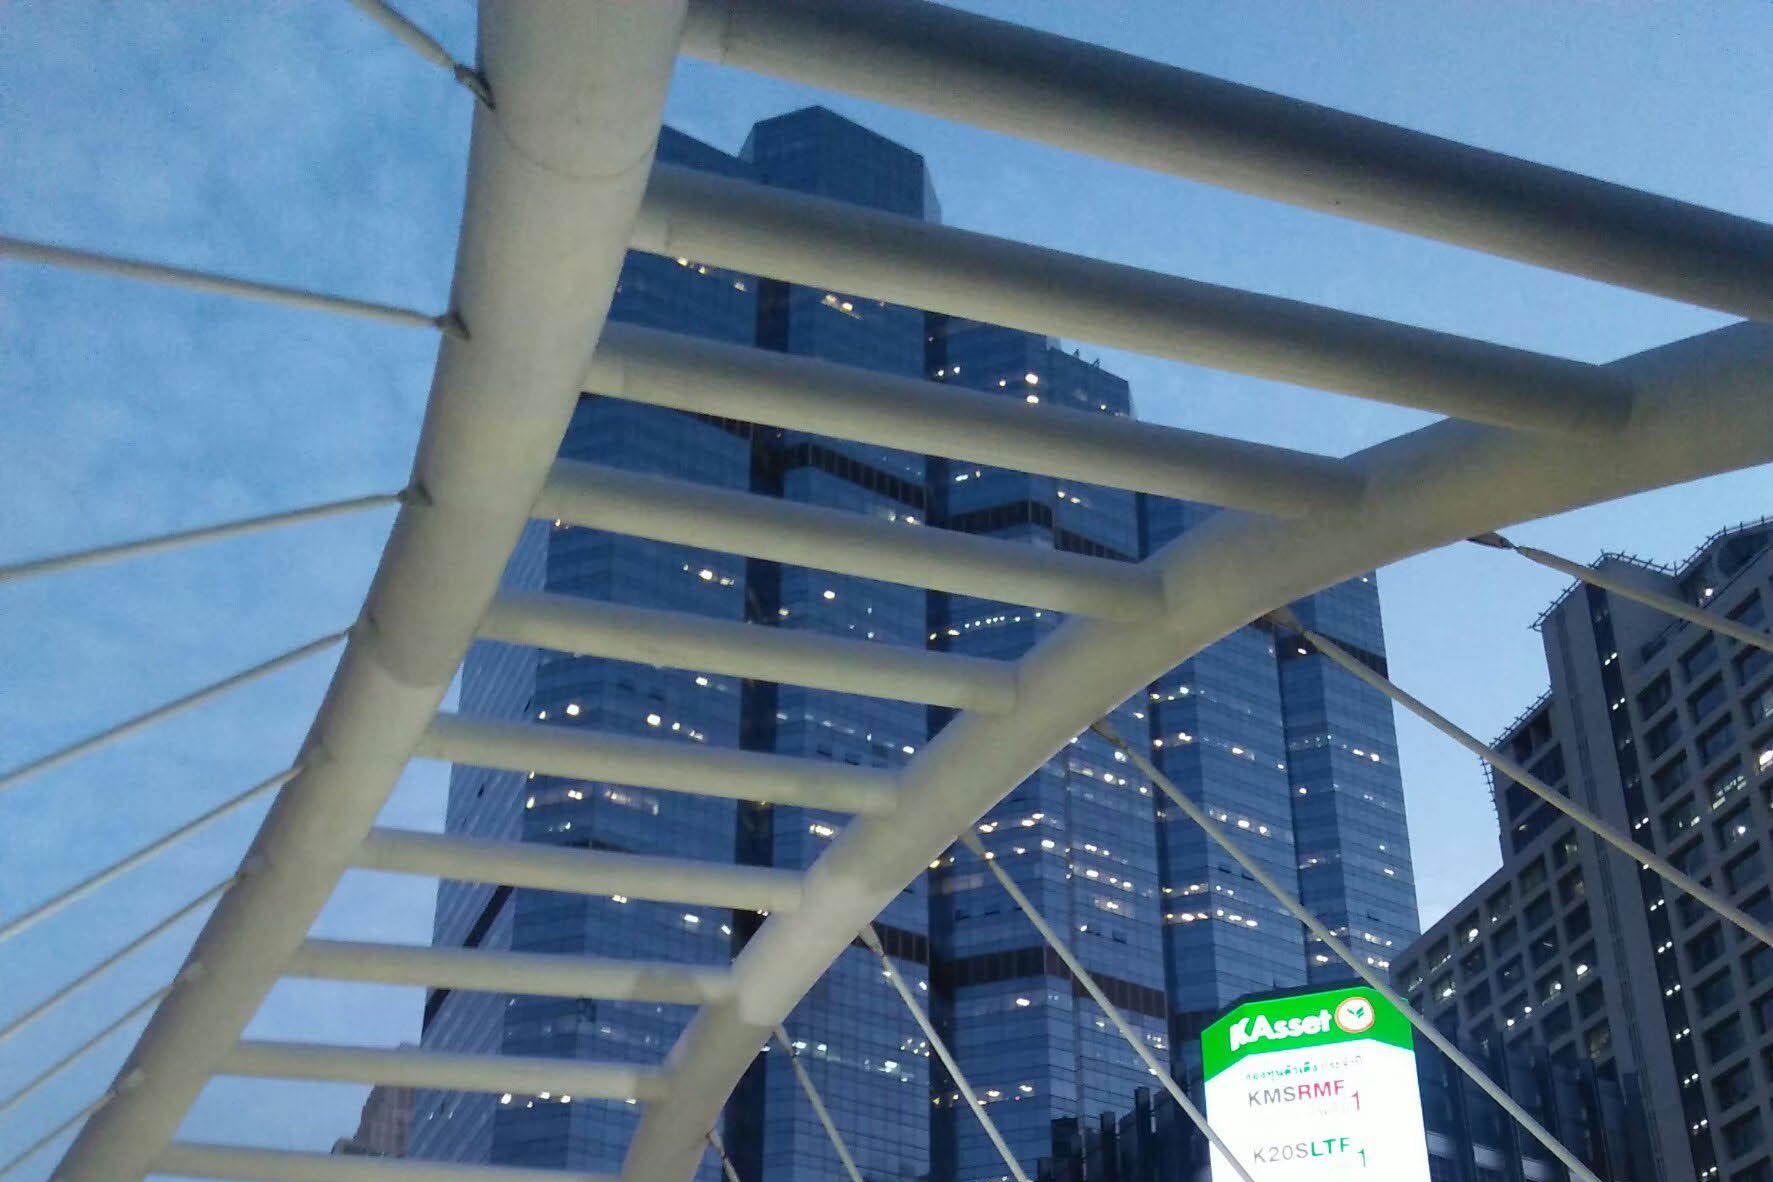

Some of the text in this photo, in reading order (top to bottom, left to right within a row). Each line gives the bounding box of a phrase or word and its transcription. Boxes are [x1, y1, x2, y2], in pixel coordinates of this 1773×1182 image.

[1229, 1009, 1332, 1052] KAsset
[1248, 1079, 1345, 1107] KMSRMF
[1253, 1137, 1351, 1163] K20SLTF
